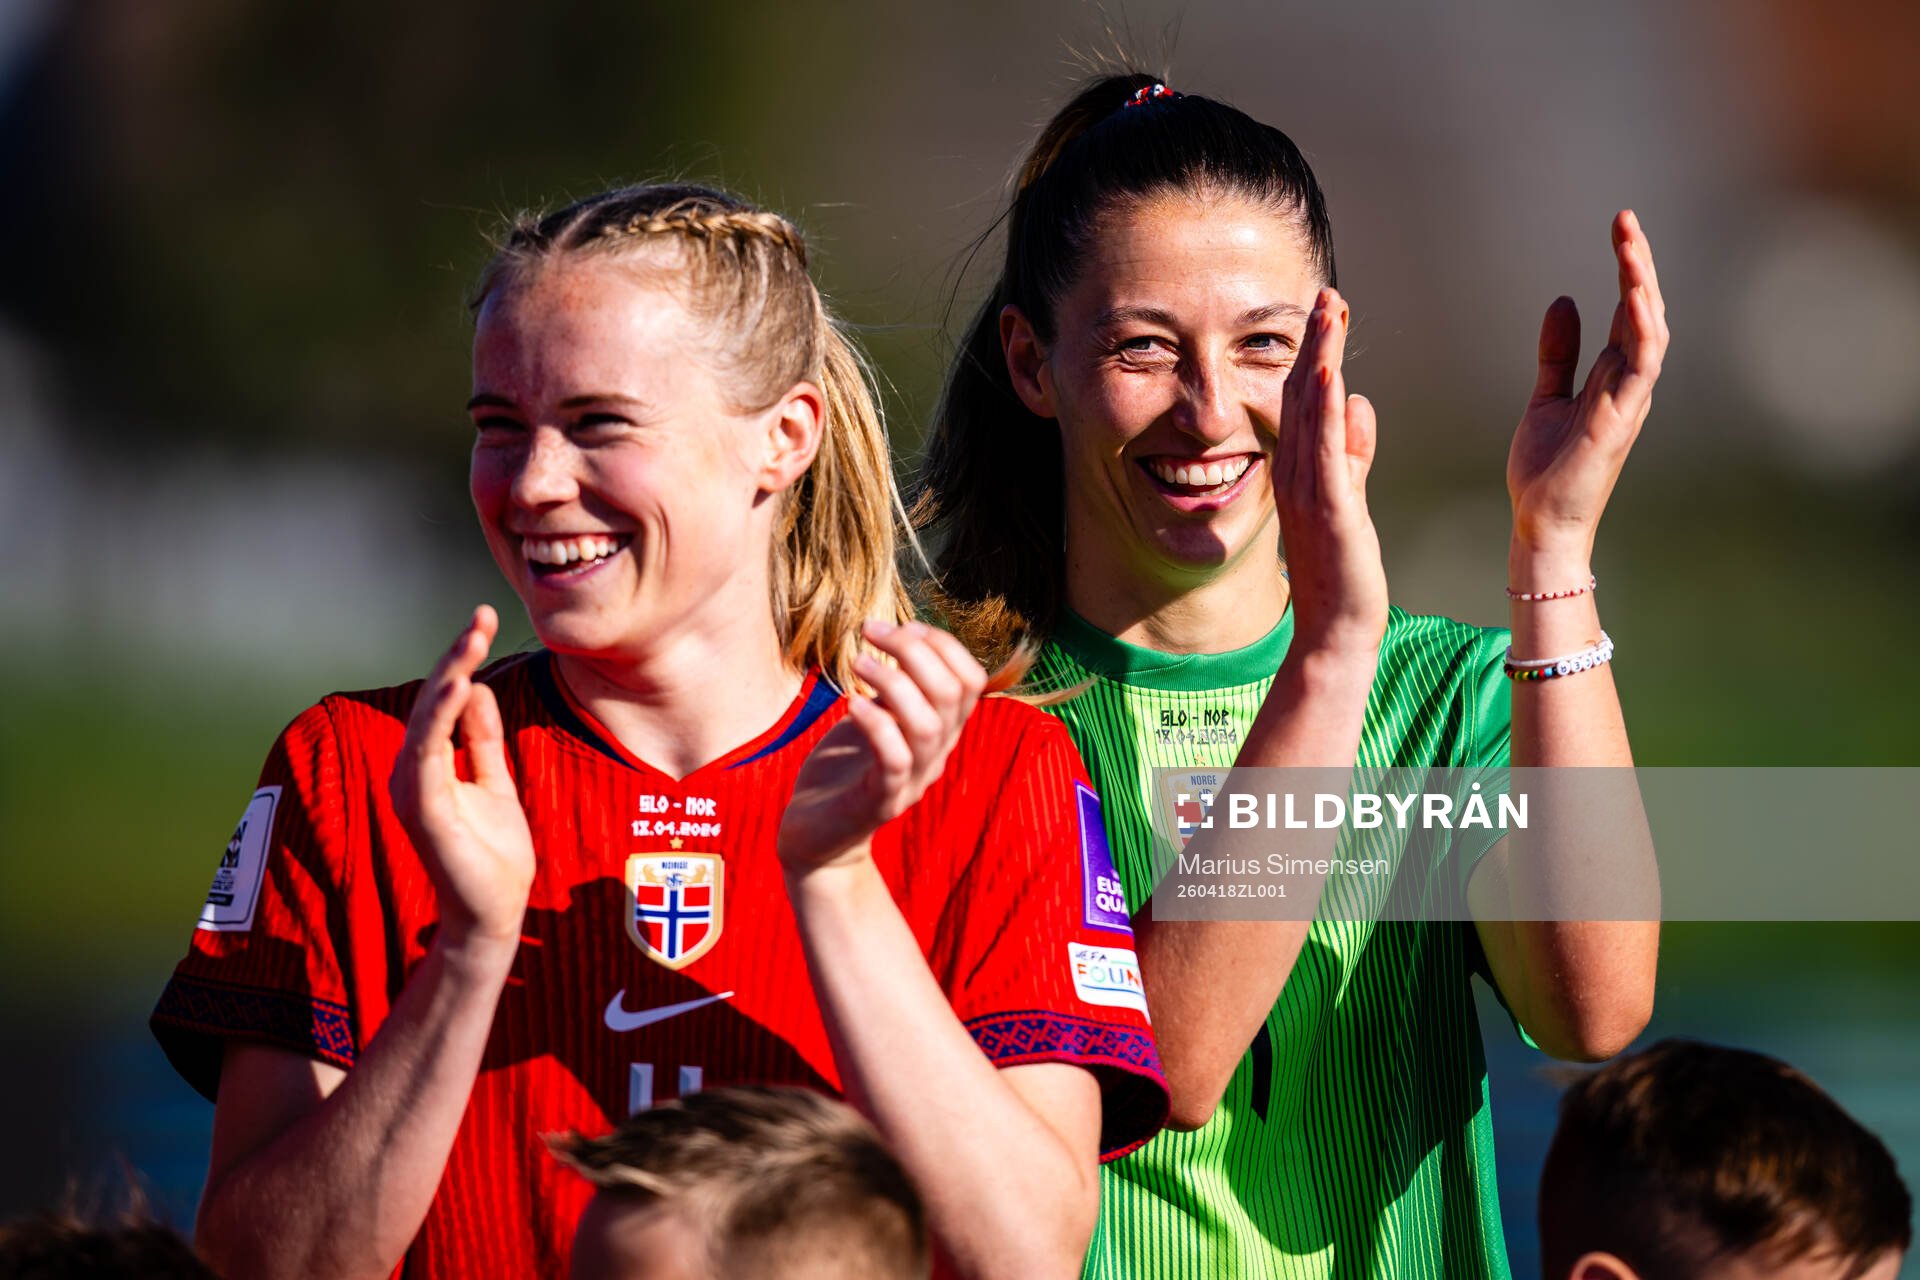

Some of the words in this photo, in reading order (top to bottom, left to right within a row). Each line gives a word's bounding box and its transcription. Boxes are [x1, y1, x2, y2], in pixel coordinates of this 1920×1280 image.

[1161, 709, 1187, 726] SLO
[1204, 709, 1229, 726] NOR
[1156, 728, 1237, 745] 18.04.2026
[1190, 775, 1217, 785] NORGE
[639, 794, 669, 814] SLO
[685, 796, 717, 817] NOR
